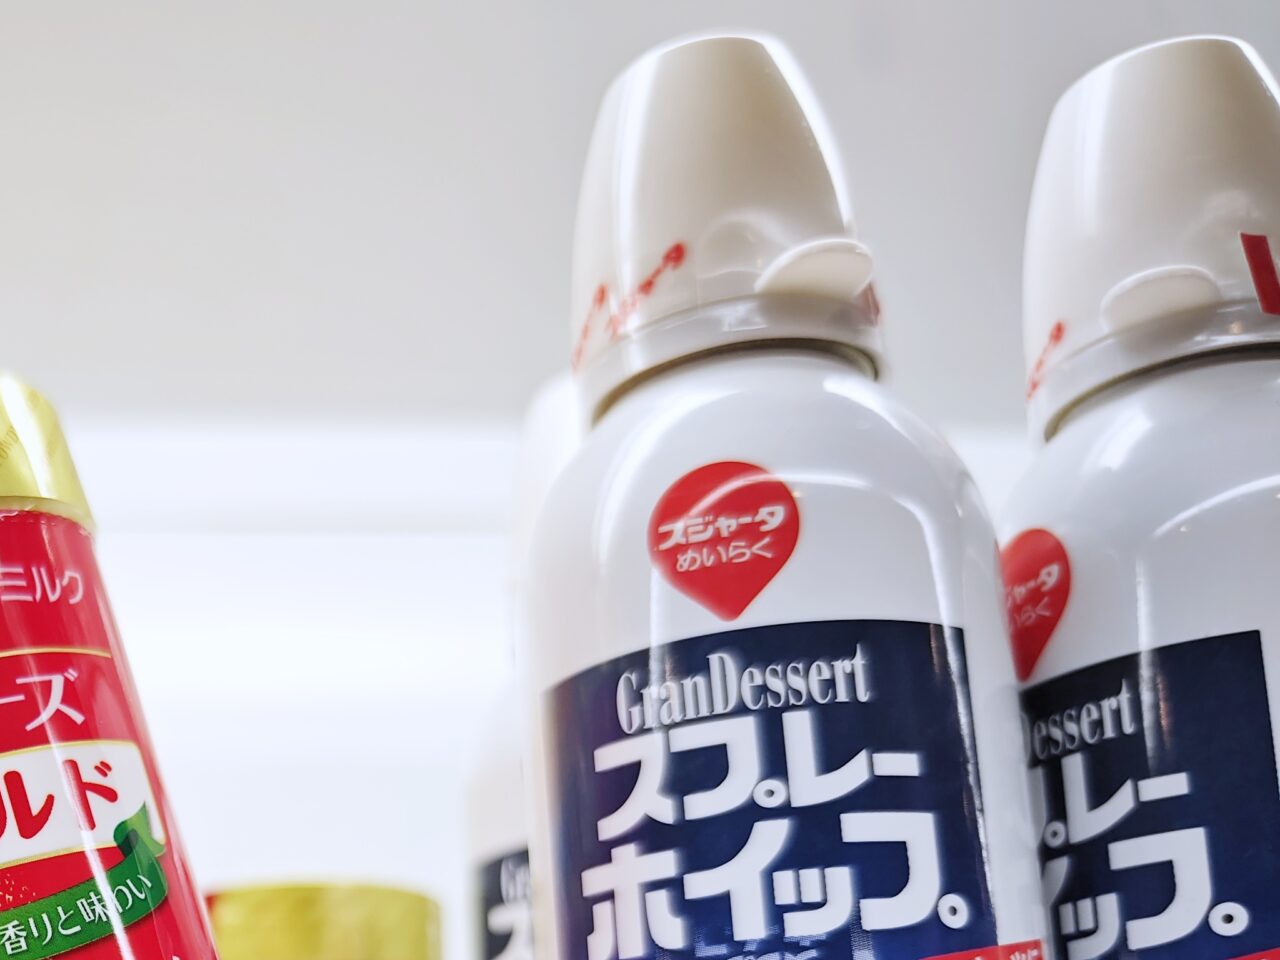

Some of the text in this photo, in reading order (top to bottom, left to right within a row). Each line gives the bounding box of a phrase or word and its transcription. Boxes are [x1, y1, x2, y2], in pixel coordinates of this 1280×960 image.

[658, 505, 785, 550] スジャータ
[676, 537, 773, 572] めいらく
[616, 642, 871, 736] GranDessert
[1022, 678, 1137, 766] essert
[593, 710, 920, 842] スプレー
